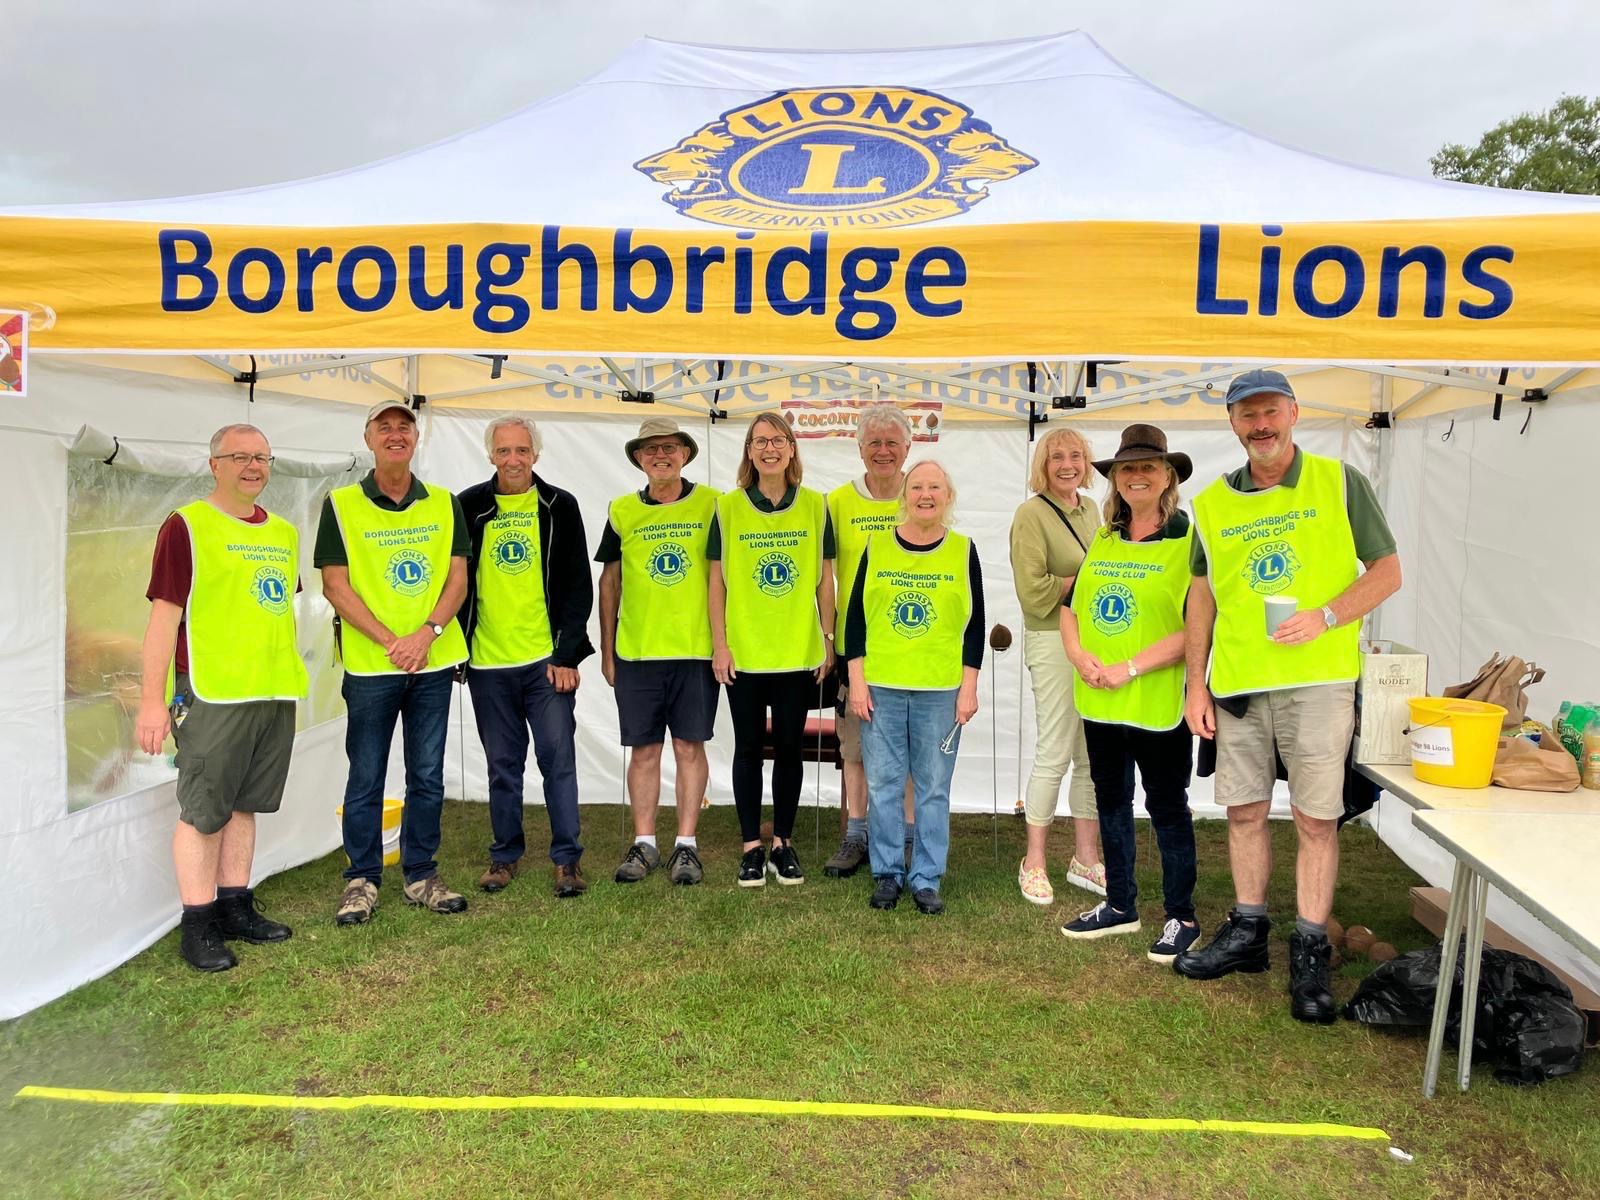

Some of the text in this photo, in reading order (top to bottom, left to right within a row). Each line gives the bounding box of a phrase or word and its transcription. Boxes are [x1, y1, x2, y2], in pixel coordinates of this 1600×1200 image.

[742, 92, 953, 135] LIONS
[788, 144, 886, 194] L
[704, 203, 945, 228] INTERNATIONAL
[158, 224, 1514, 340] Boroughbridge Lions
[798, 412, 860, 427] COCONU
[492, 521, 511, 529] LIONS
[851, 516, 895, 524] BOROUGHB
[1221, 509, 1316, 537] BOROUGHBRIDGE 98
[365, 525, 439, 538] BOROUGHBRIDGE
[634, 523, 704, 534] BOROUGHBRIDGE
[1242, 522, 1295, 542] LIONS CLUB
[379, 535, 430, 546] LIONS CLUB
[500, 532, 525, 542] LIONS
[739, 531, 808, 540] BOROUGHBRIDGE
[507, 544, 520, 560] L
[655, 544, 680, 554] LIONS
[1254, 543, 1286, 558] LIONS
[242, 553, 267, 561] LIONS
[393, 551, 421, 562] LIONS
[762, 554, 788, 563] LIONS
[663, 556, 675, 571] L
[1264, 558, 1279, 576] L
[257, 568, 284, 579] LIONS
[403, 564, 418, 580] L
[771, 566, 783, 581] L
[877, 571, 941, 581] BOROUGHBRIDGE
[1094, 569, 1120, 577] LIONS
[267, 581, 281, 598] L
[891, 579, 913, 588] LIONS
[1101, 585, 1129, 596] LIONS
[899, 593, 927, 604] LIONS
[906, 605, 918, 622] L
[1105, 598, 1119, 617] L
